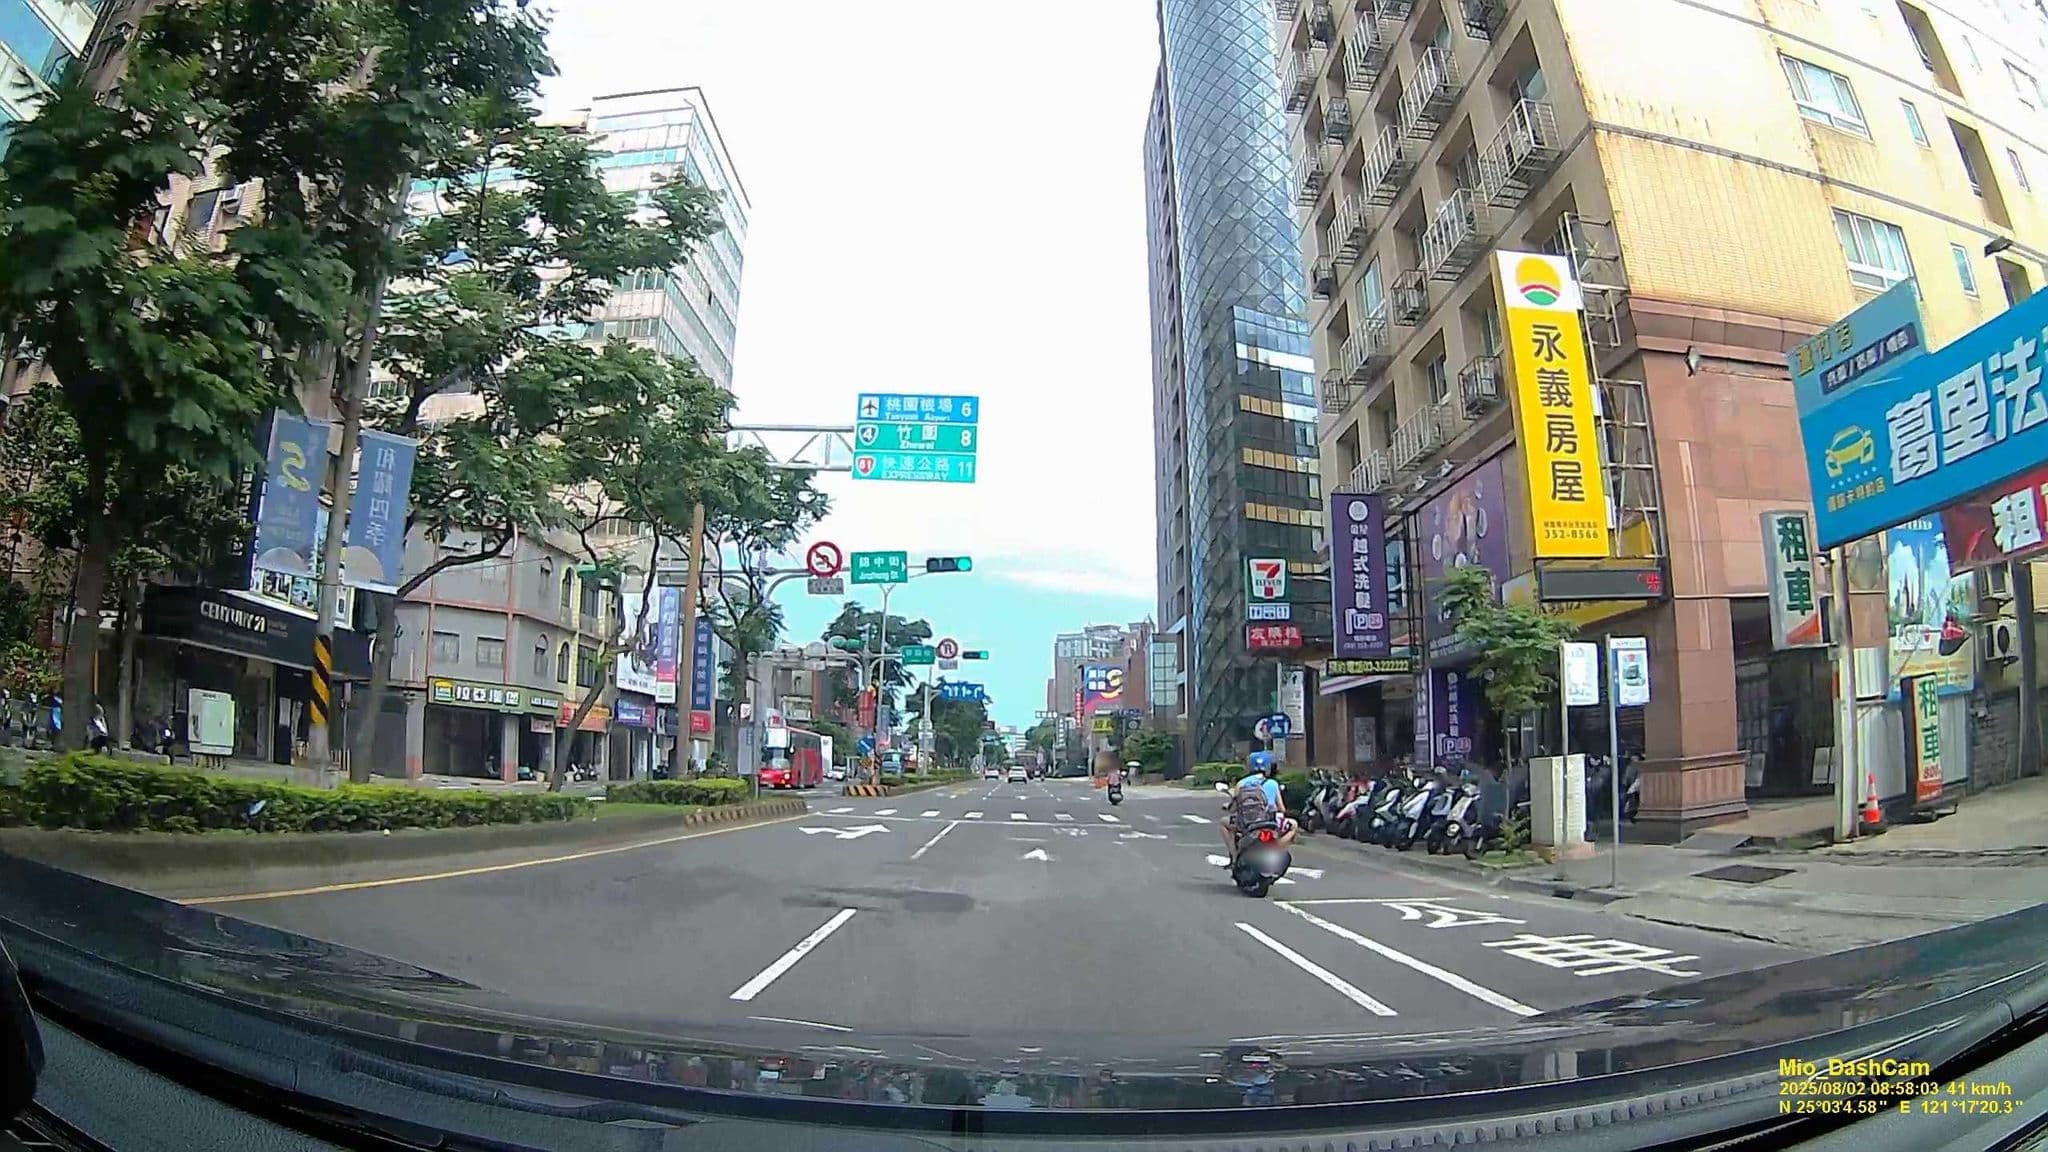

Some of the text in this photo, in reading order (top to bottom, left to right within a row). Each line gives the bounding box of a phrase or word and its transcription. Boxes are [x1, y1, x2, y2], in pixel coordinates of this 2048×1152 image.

[885, 396, 972, 417] 桃園機場 6
[1531, 323, 1585, 502] 永義房屋
[863, 427, 873, 442] 4
[960, 430, 972, 447] 8
[958, 462, 973, 478] 11
[1991, 483, 2048, 553] 租
[1544, 530, 1599, 539] 352-8566
[1776, 516, 1814, 616] 租車
[200, 600, 254, 630] CENTURY
[1918, 680, 1940, 763] 租車
